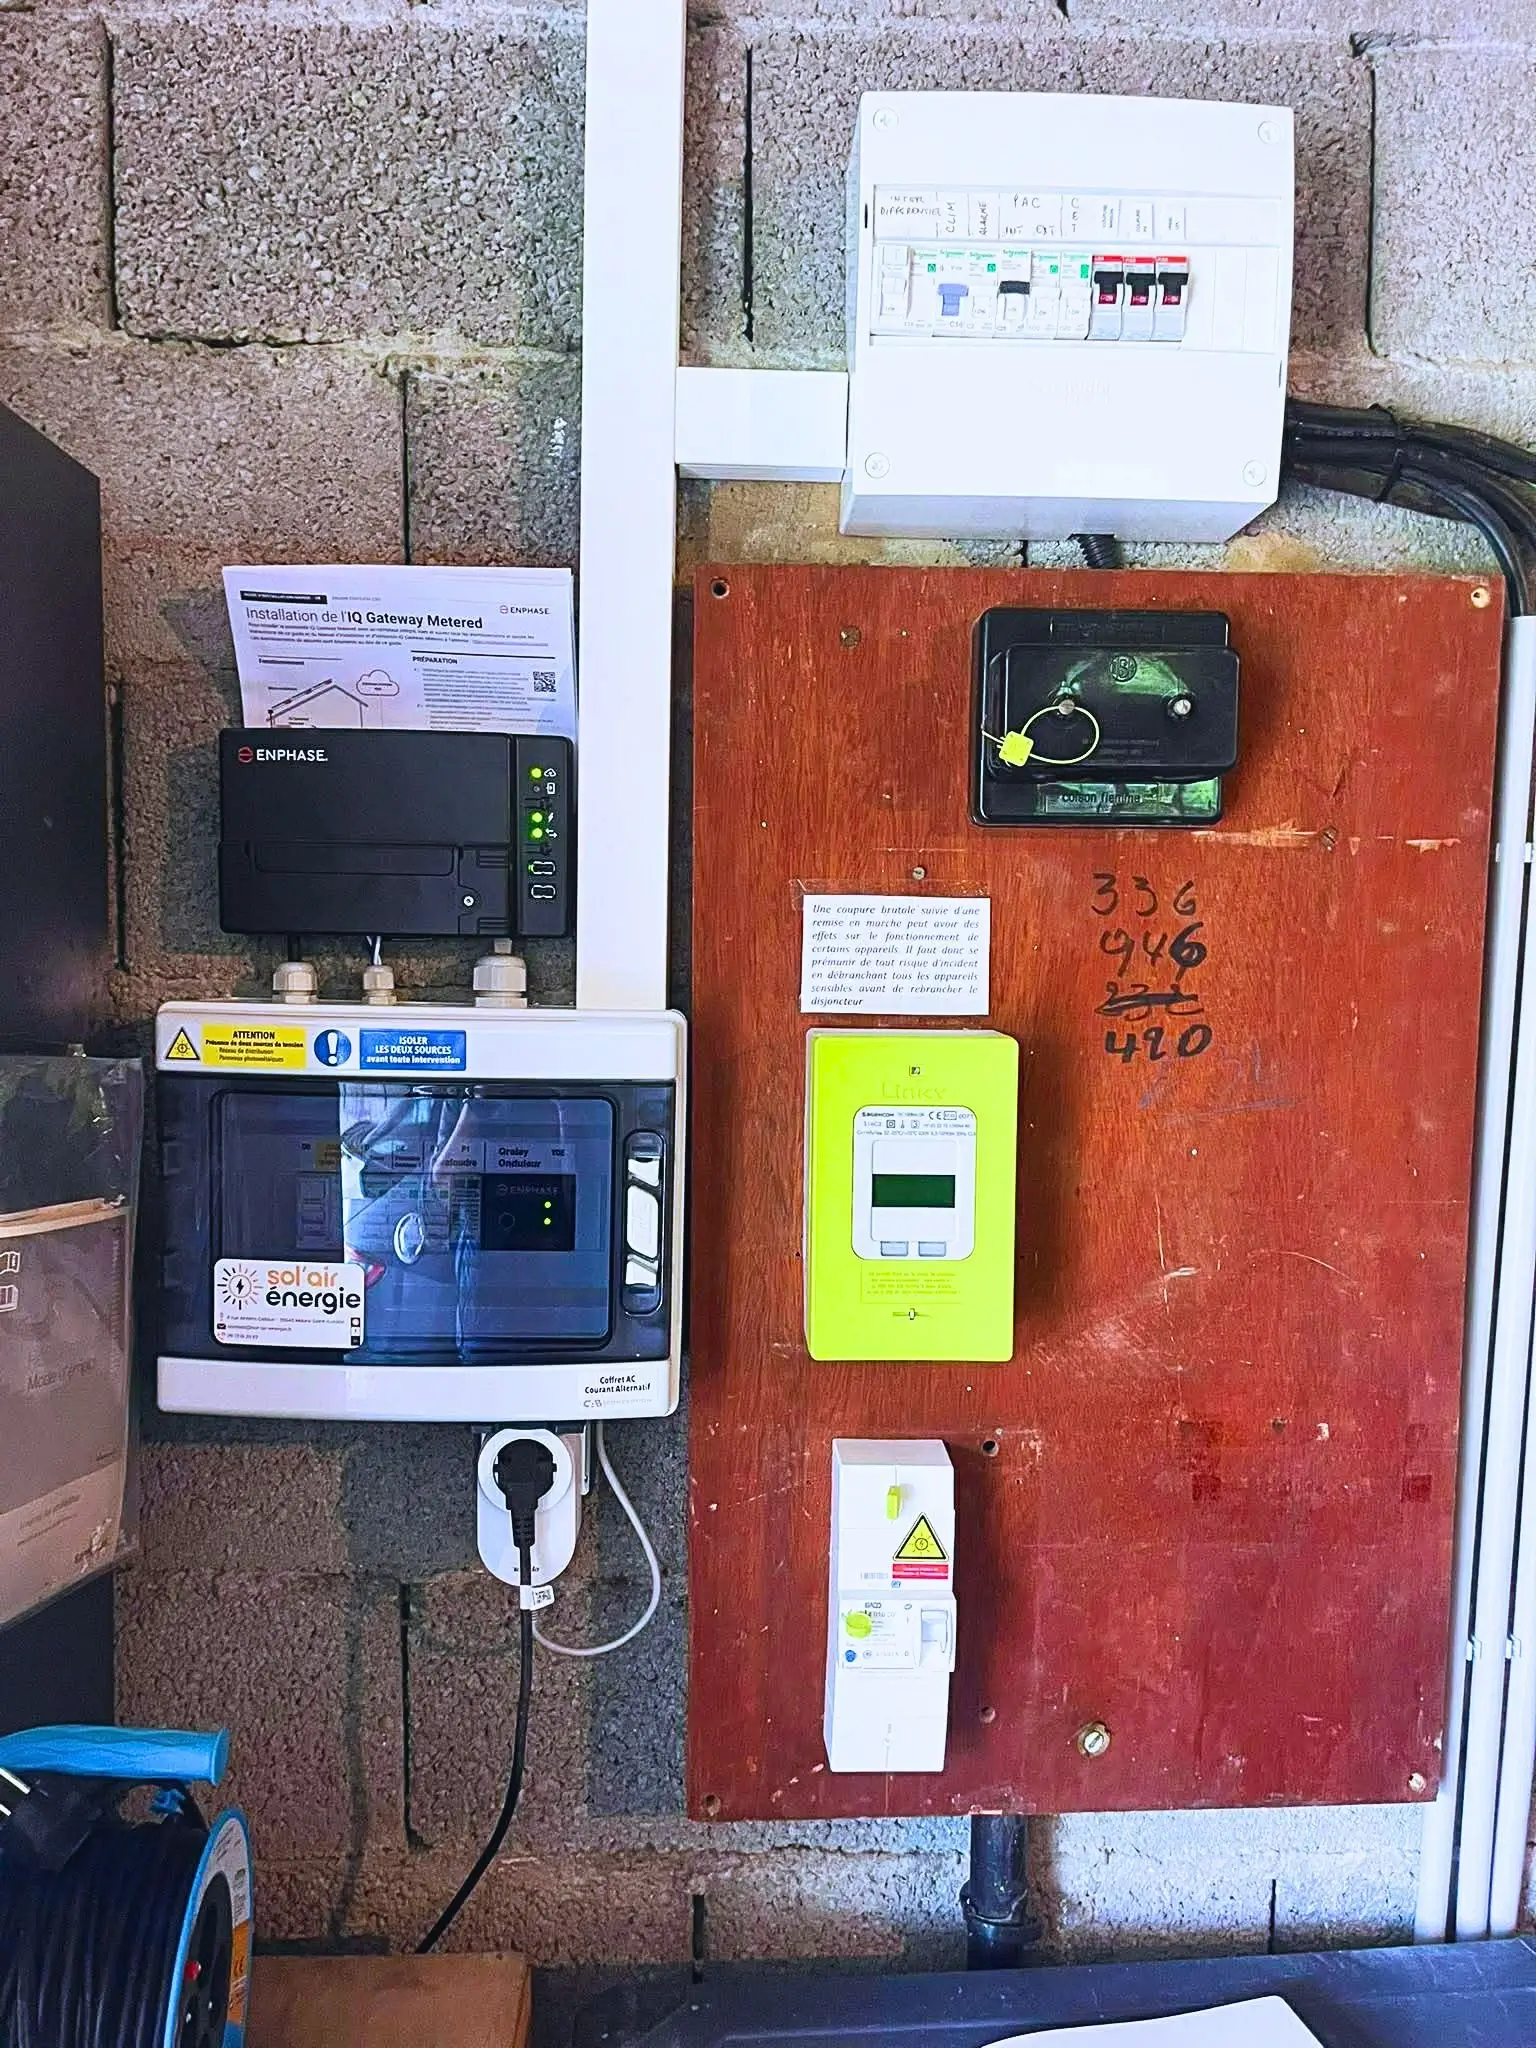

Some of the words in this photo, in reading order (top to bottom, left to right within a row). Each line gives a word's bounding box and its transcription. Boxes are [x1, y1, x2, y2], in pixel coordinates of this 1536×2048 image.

[246, 606, 318, 624] Installation
[321, 610, 338, 623] de
[366, 611, 423, 629] Gateway
[427, 613, 483, 629] Metered
[256, 748, 326, 761] ENPHASE
[813, 904, 831, 914] Une
[837, 907, 876, 916] coupure
[881, 905, 916, 915] brutale
[921, 907, 948, 915] suivie
[954, 907, 980, 916] d'une
[812, 919, 844, 927] remise
[866, 919, 902, 928] marche
[907, 920, 927, 930] peut
[934, 920, 958, 928] avoir
[964, 920, 979, 929] des
[812, 931, 837, 942] effets
[869, 932, 877, 940] le
[885, 932, 959, 943] fonctionnement
[968, 933, 979, 941] de
[812, 945, 849, 953] certains
[906, 945, 913, 954] Il
[917, 945, 936, 956] faut
[942, 946, 964, 954] donc
[811, 958, 856, 968] prémunir
[860, 959, 871, 967] de
[876, 959, 894, 967] tout
[899, 959, 928, 969] risque
[932, 959, 978, 968] d'incident
[827, 971, 887, 980] débranchant
[892, 972, 912, 980] tous
[917, 972, 929, 980] les
[934, 972, 978, 982] appareils
[811, 984, 852, 993] sensibles
[859, 985, 885, 993] avant
[893, 985, 904, 993] de
[910, 985, 962, 994] rebrancher
[969, 985, 978, 994] le
[811, 997, 863, 1008] disjoncteur
[233, 1031, 275, 1039] ATTENTION
[400, 1036, 428, 1044] ISOLER
[391, 1046, 413, 1054] DEUX
[415, 1046, 451, 1054] SOURCES
[412, 1056, 460, 1064] intervention
[498, 1159, 541, 1167] Onduleur
[267, 1266, 338, 1287] sol'air
[266, 1286, 360, 1314] énergie
[600, 1376, 624, 1384] Coffret
[585, 1386, 614, 1394] Courant
[616, 1383, 651, 1392] Alternatif
